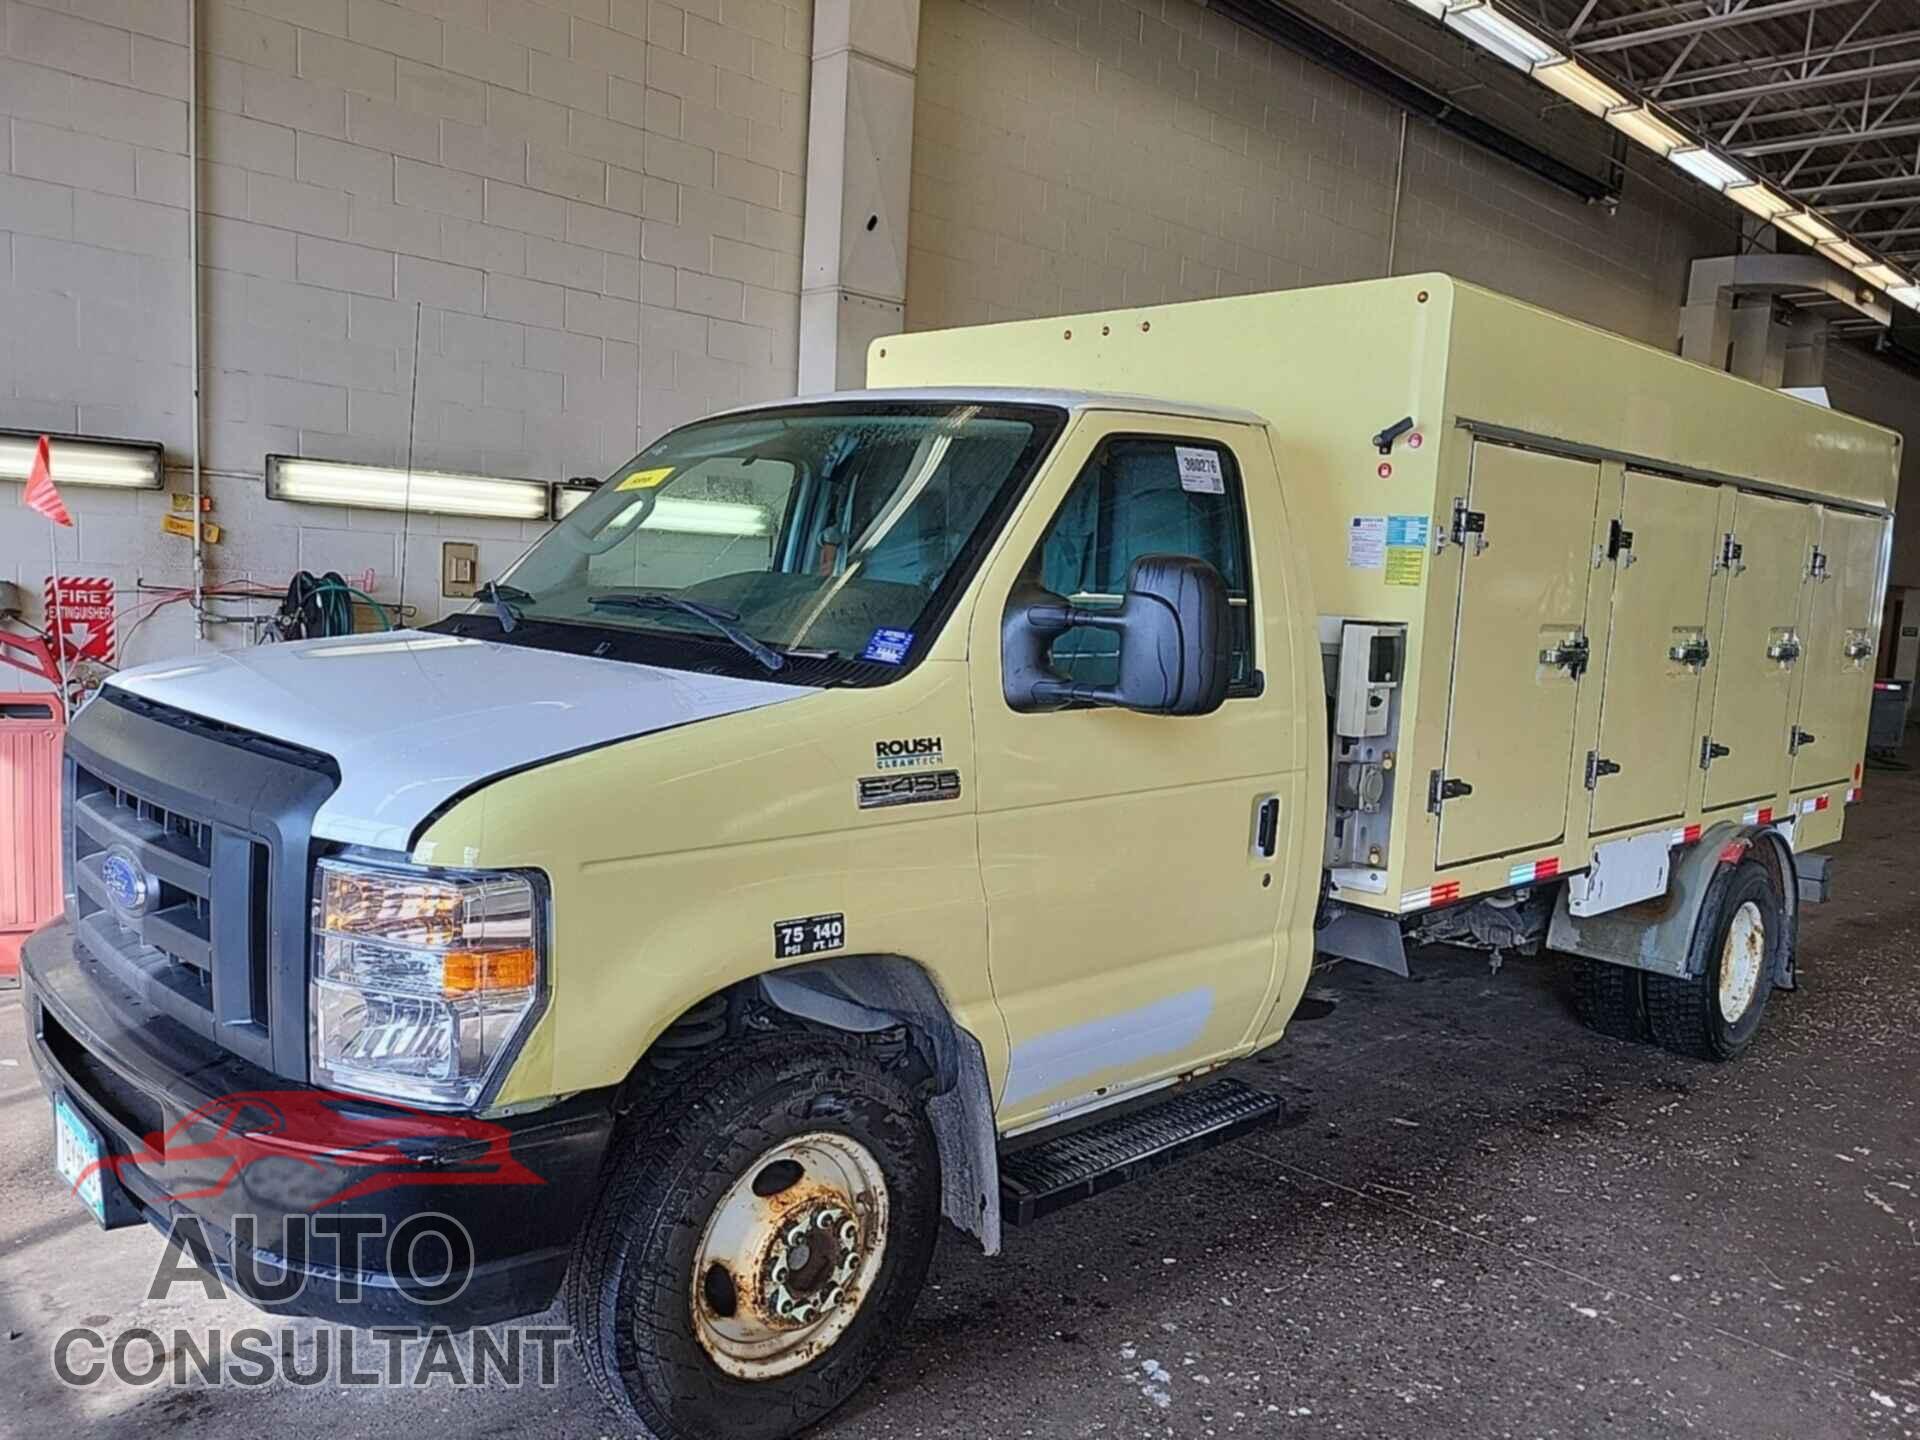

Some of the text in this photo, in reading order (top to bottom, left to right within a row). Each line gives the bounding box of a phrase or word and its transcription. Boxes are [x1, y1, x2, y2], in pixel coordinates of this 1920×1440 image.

[58, 589, 102, 604] FIRE
[876, 737, 942, 757] ROUSH
[781, 926, 804, 945] 75
[813, 921, 842, 940] 140
[785, 944, 801, 956] PSI
